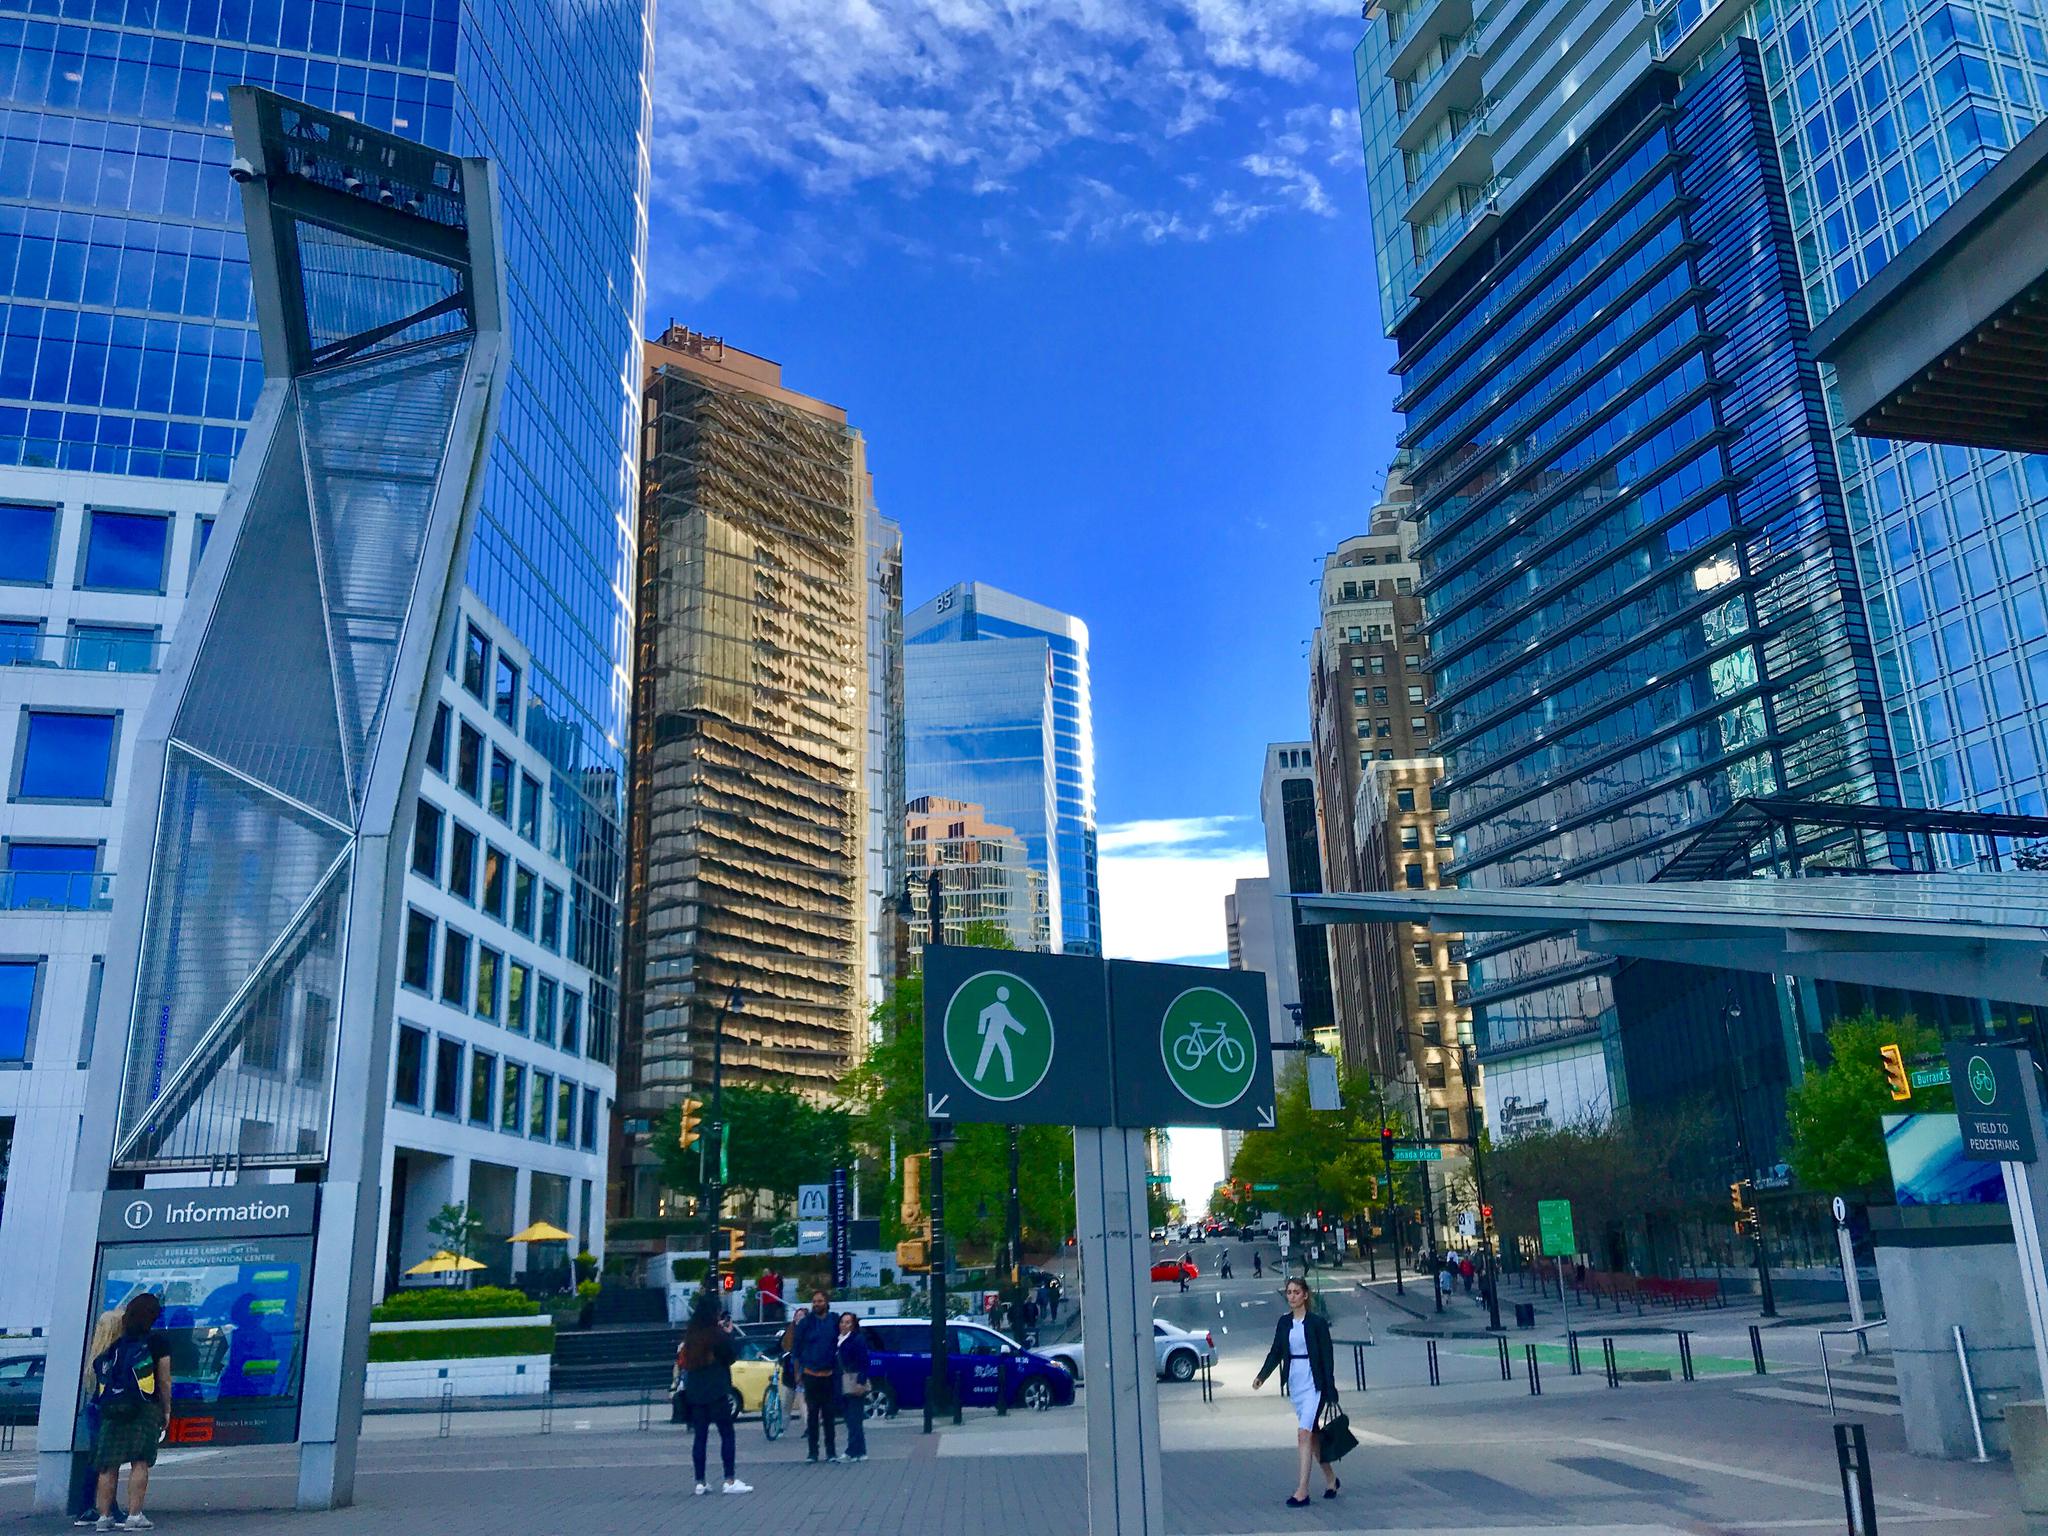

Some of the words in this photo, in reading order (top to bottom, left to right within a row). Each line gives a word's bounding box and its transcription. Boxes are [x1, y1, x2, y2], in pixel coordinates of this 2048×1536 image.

[1917, 1070, 1944, 1085] Burrard
[1500, 1095, 1549, 1123] Fairmont
[1974, 1122, 1996, 1134] YIELD
[1998, 1122, 2009, 1135] TO
[1969, 1138, 2020, 1151] PEDESTRIANS
[1395, 1150, 1417, 1160] anada
[1419, 1150, 1439, 1160] Place
[165, 1200, 290, 1224] Information
[136, 1257, 185, 1267] VANCOUVER
[185, 1254, 242, 1265] CONVENTION
[244, 1253, 276, 1262] CENTRE
